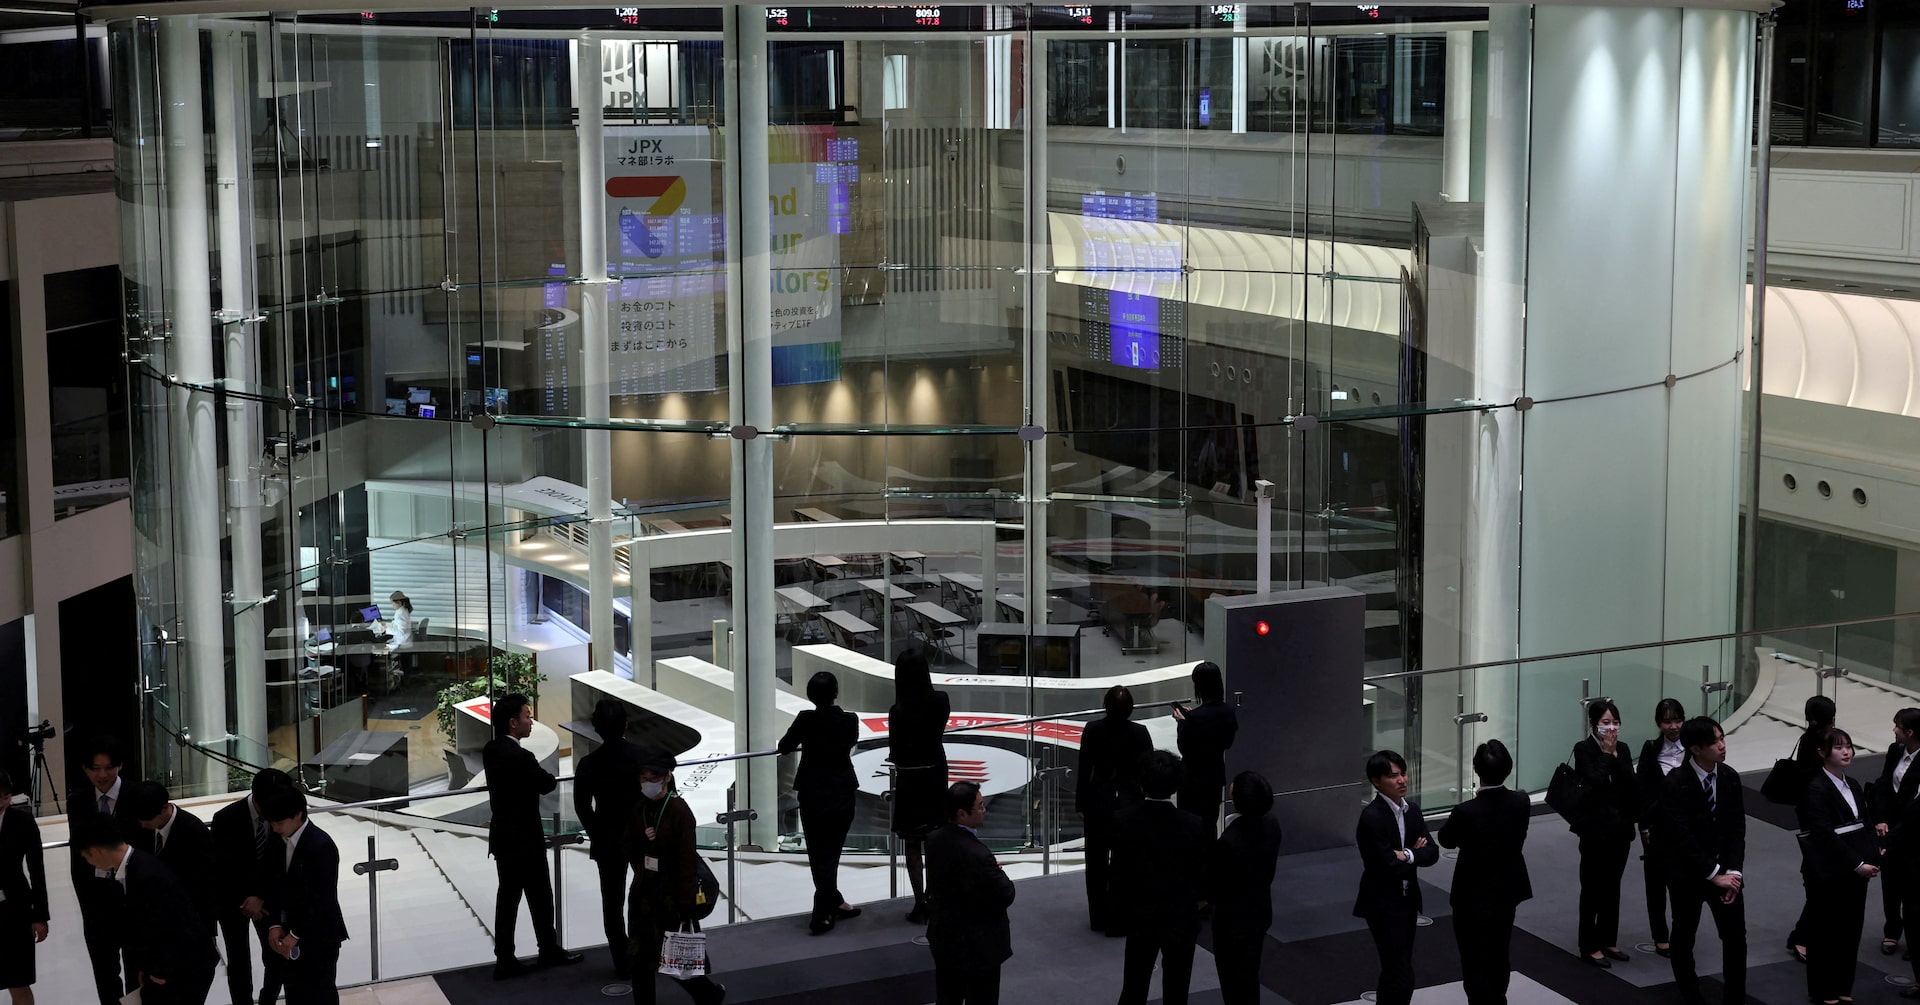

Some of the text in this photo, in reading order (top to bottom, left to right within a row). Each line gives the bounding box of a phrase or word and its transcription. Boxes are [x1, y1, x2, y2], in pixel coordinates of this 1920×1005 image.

[615, 7, 638, 17] 1,202
[915, 9, 940, 18] 809.0
[1068, 7, 1092, 17] 1,511
[1210, 5, 1240, 15] 1,867.5
[1368, 9, 1379, 18] +5
[622, 16, 638, 24] +12
[776, 17, 788, 26] +6
[915, 17, 940, 26] +17.8
[1081, 15, 1092, 24] +6
[604, 91, 647, 108] JPX
[628, 139, 663, 154] JPX
[769, 186, 796, 216] nd
[772, 232, 803, 255] ur
[770, 265, 830, 294] lors
[620, 301, 676, 313] お金のコト
[620, 319, 676, 332] 投資のコト
[610, 338, 688, 352] まずはここから
